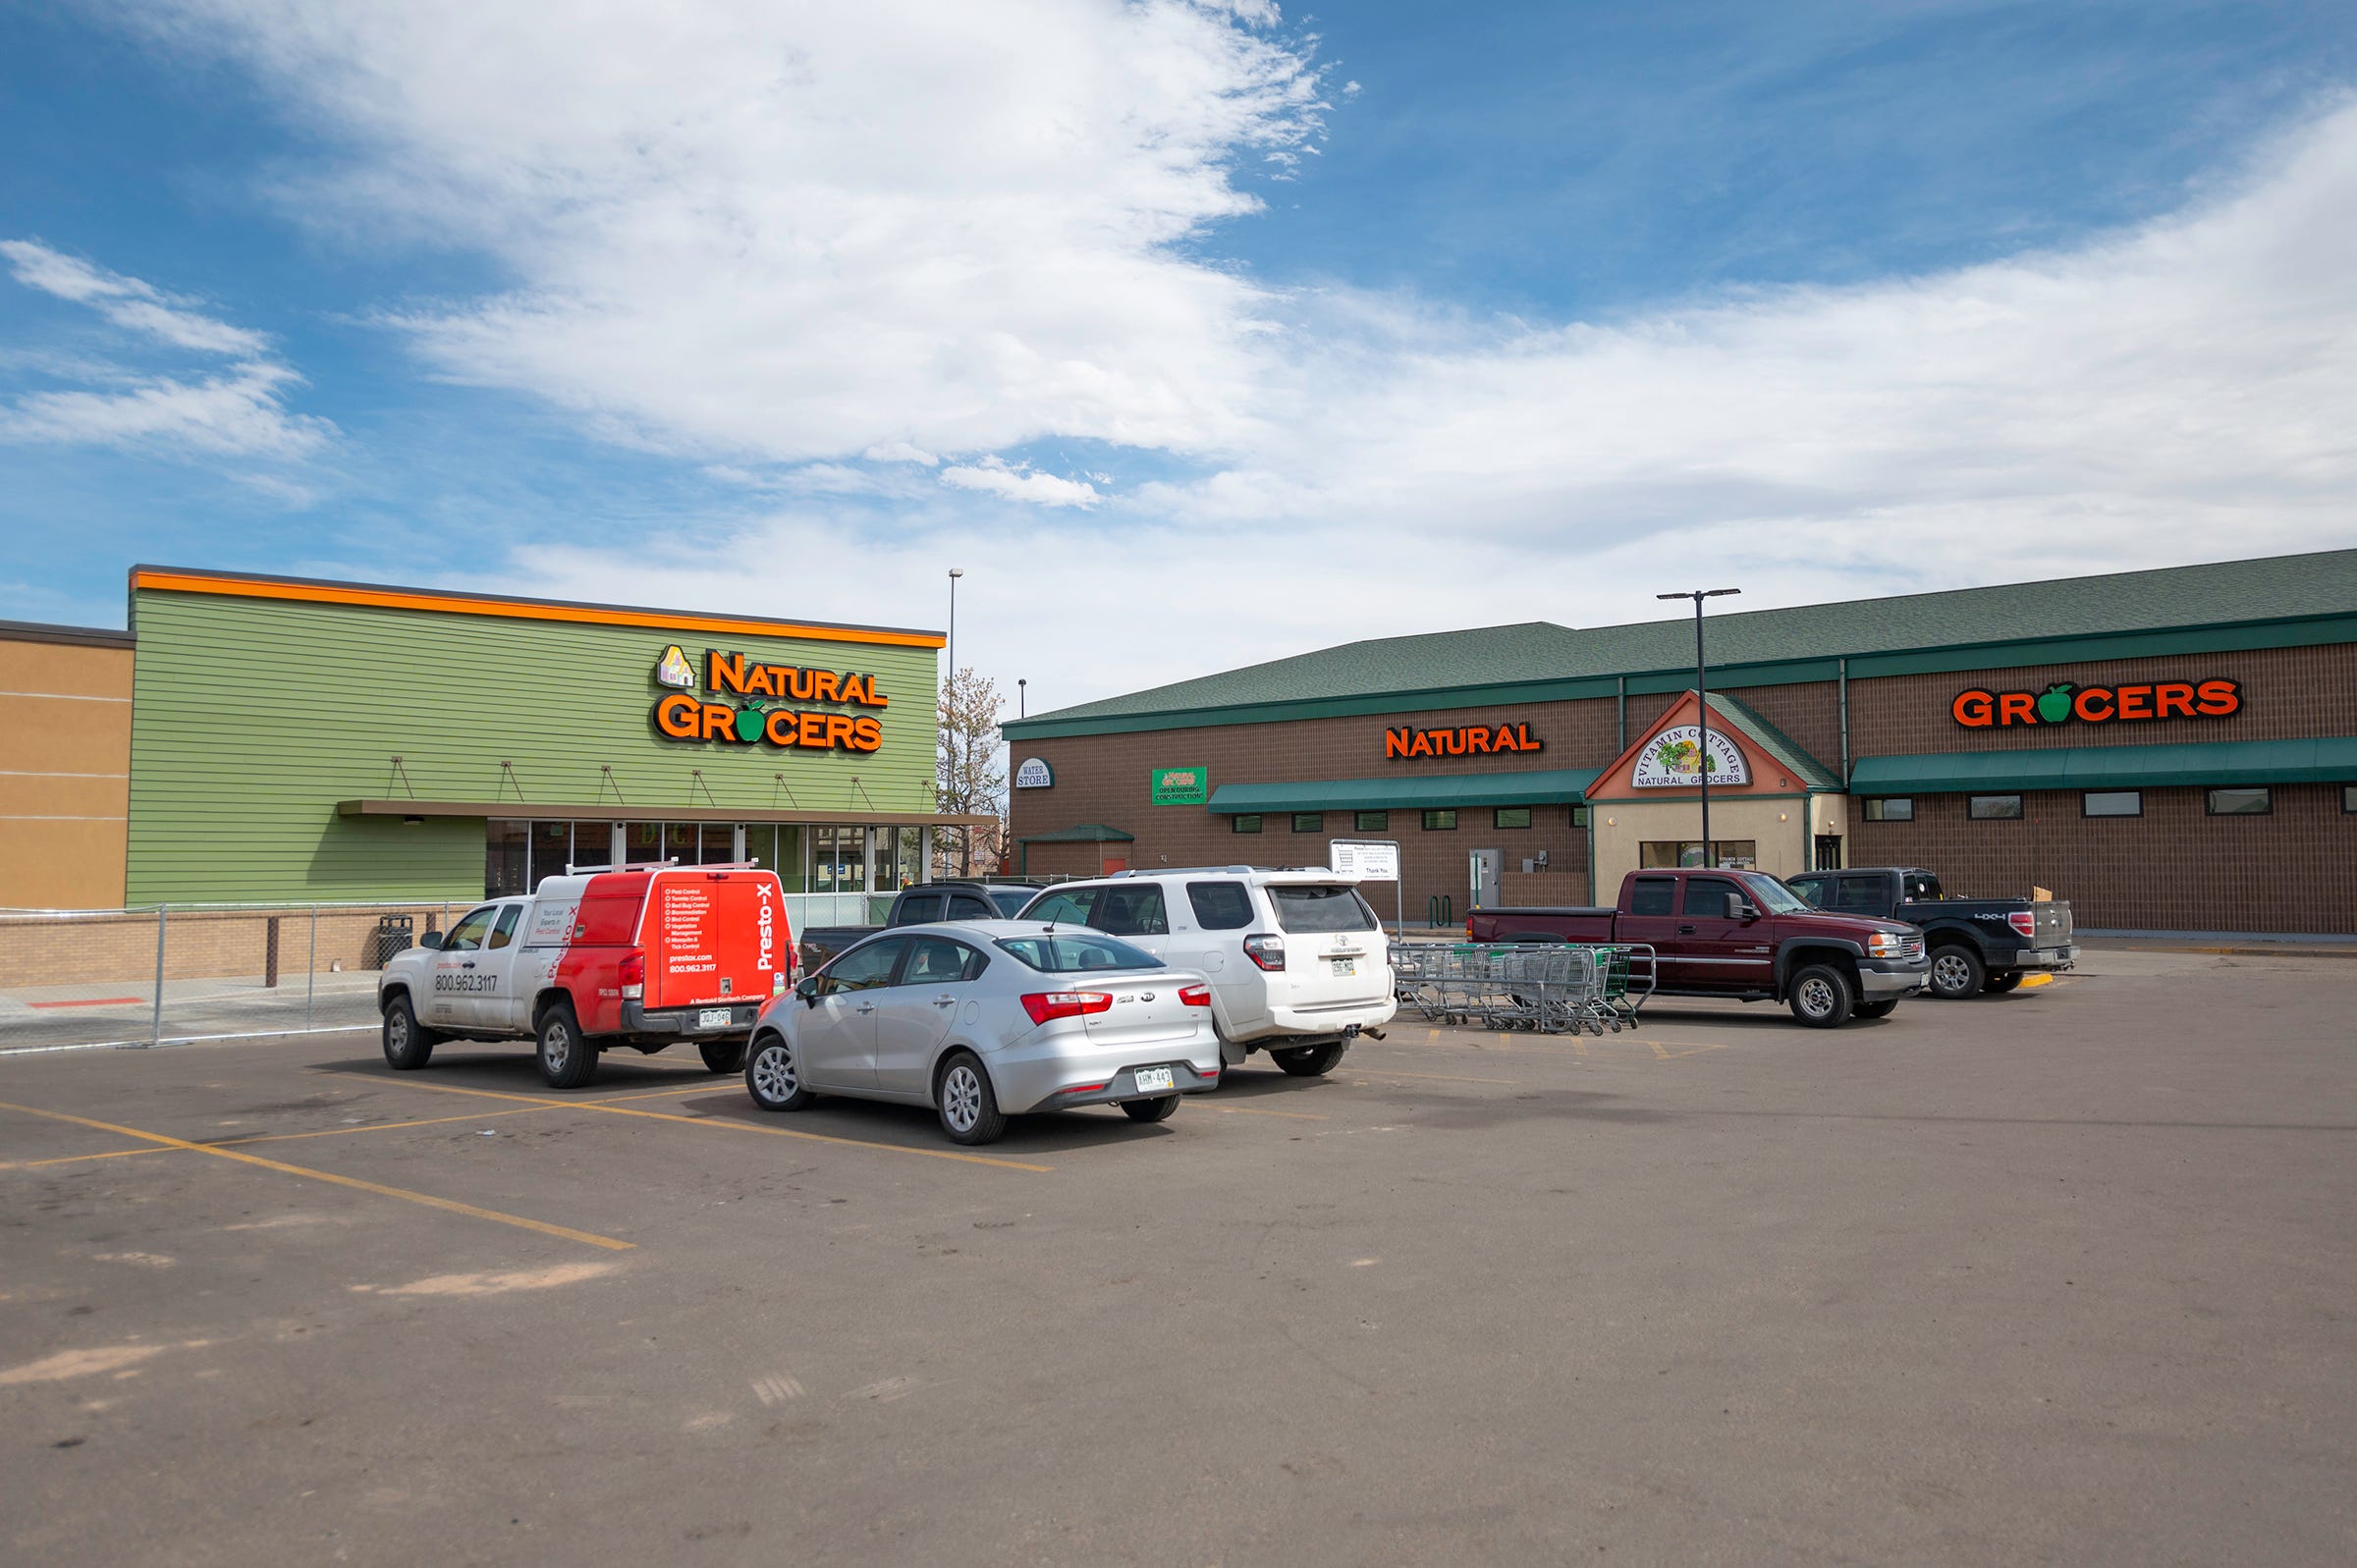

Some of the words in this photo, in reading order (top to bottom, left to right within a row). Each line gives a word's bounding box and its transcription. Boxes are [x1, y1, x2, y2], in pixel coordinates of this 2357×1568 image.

[706, 649, 888, 709] NATURAL
[1386, 724, 1541, 758] NATURAL
[1638, 730, 1682, 777] VITAMIN
[1022, 766, 1044, 775] WATER
[1017, 775, 1049, 785] STORE
[1638, 776, 1683, 785] NATURAL
[756, 883, 773, 970] Presto-X
[669, 953, 712, 962] prestox.com
[669, 964, 717, 973] 800.962.3117
[435, 974, 498, 992] 800.962.3117
